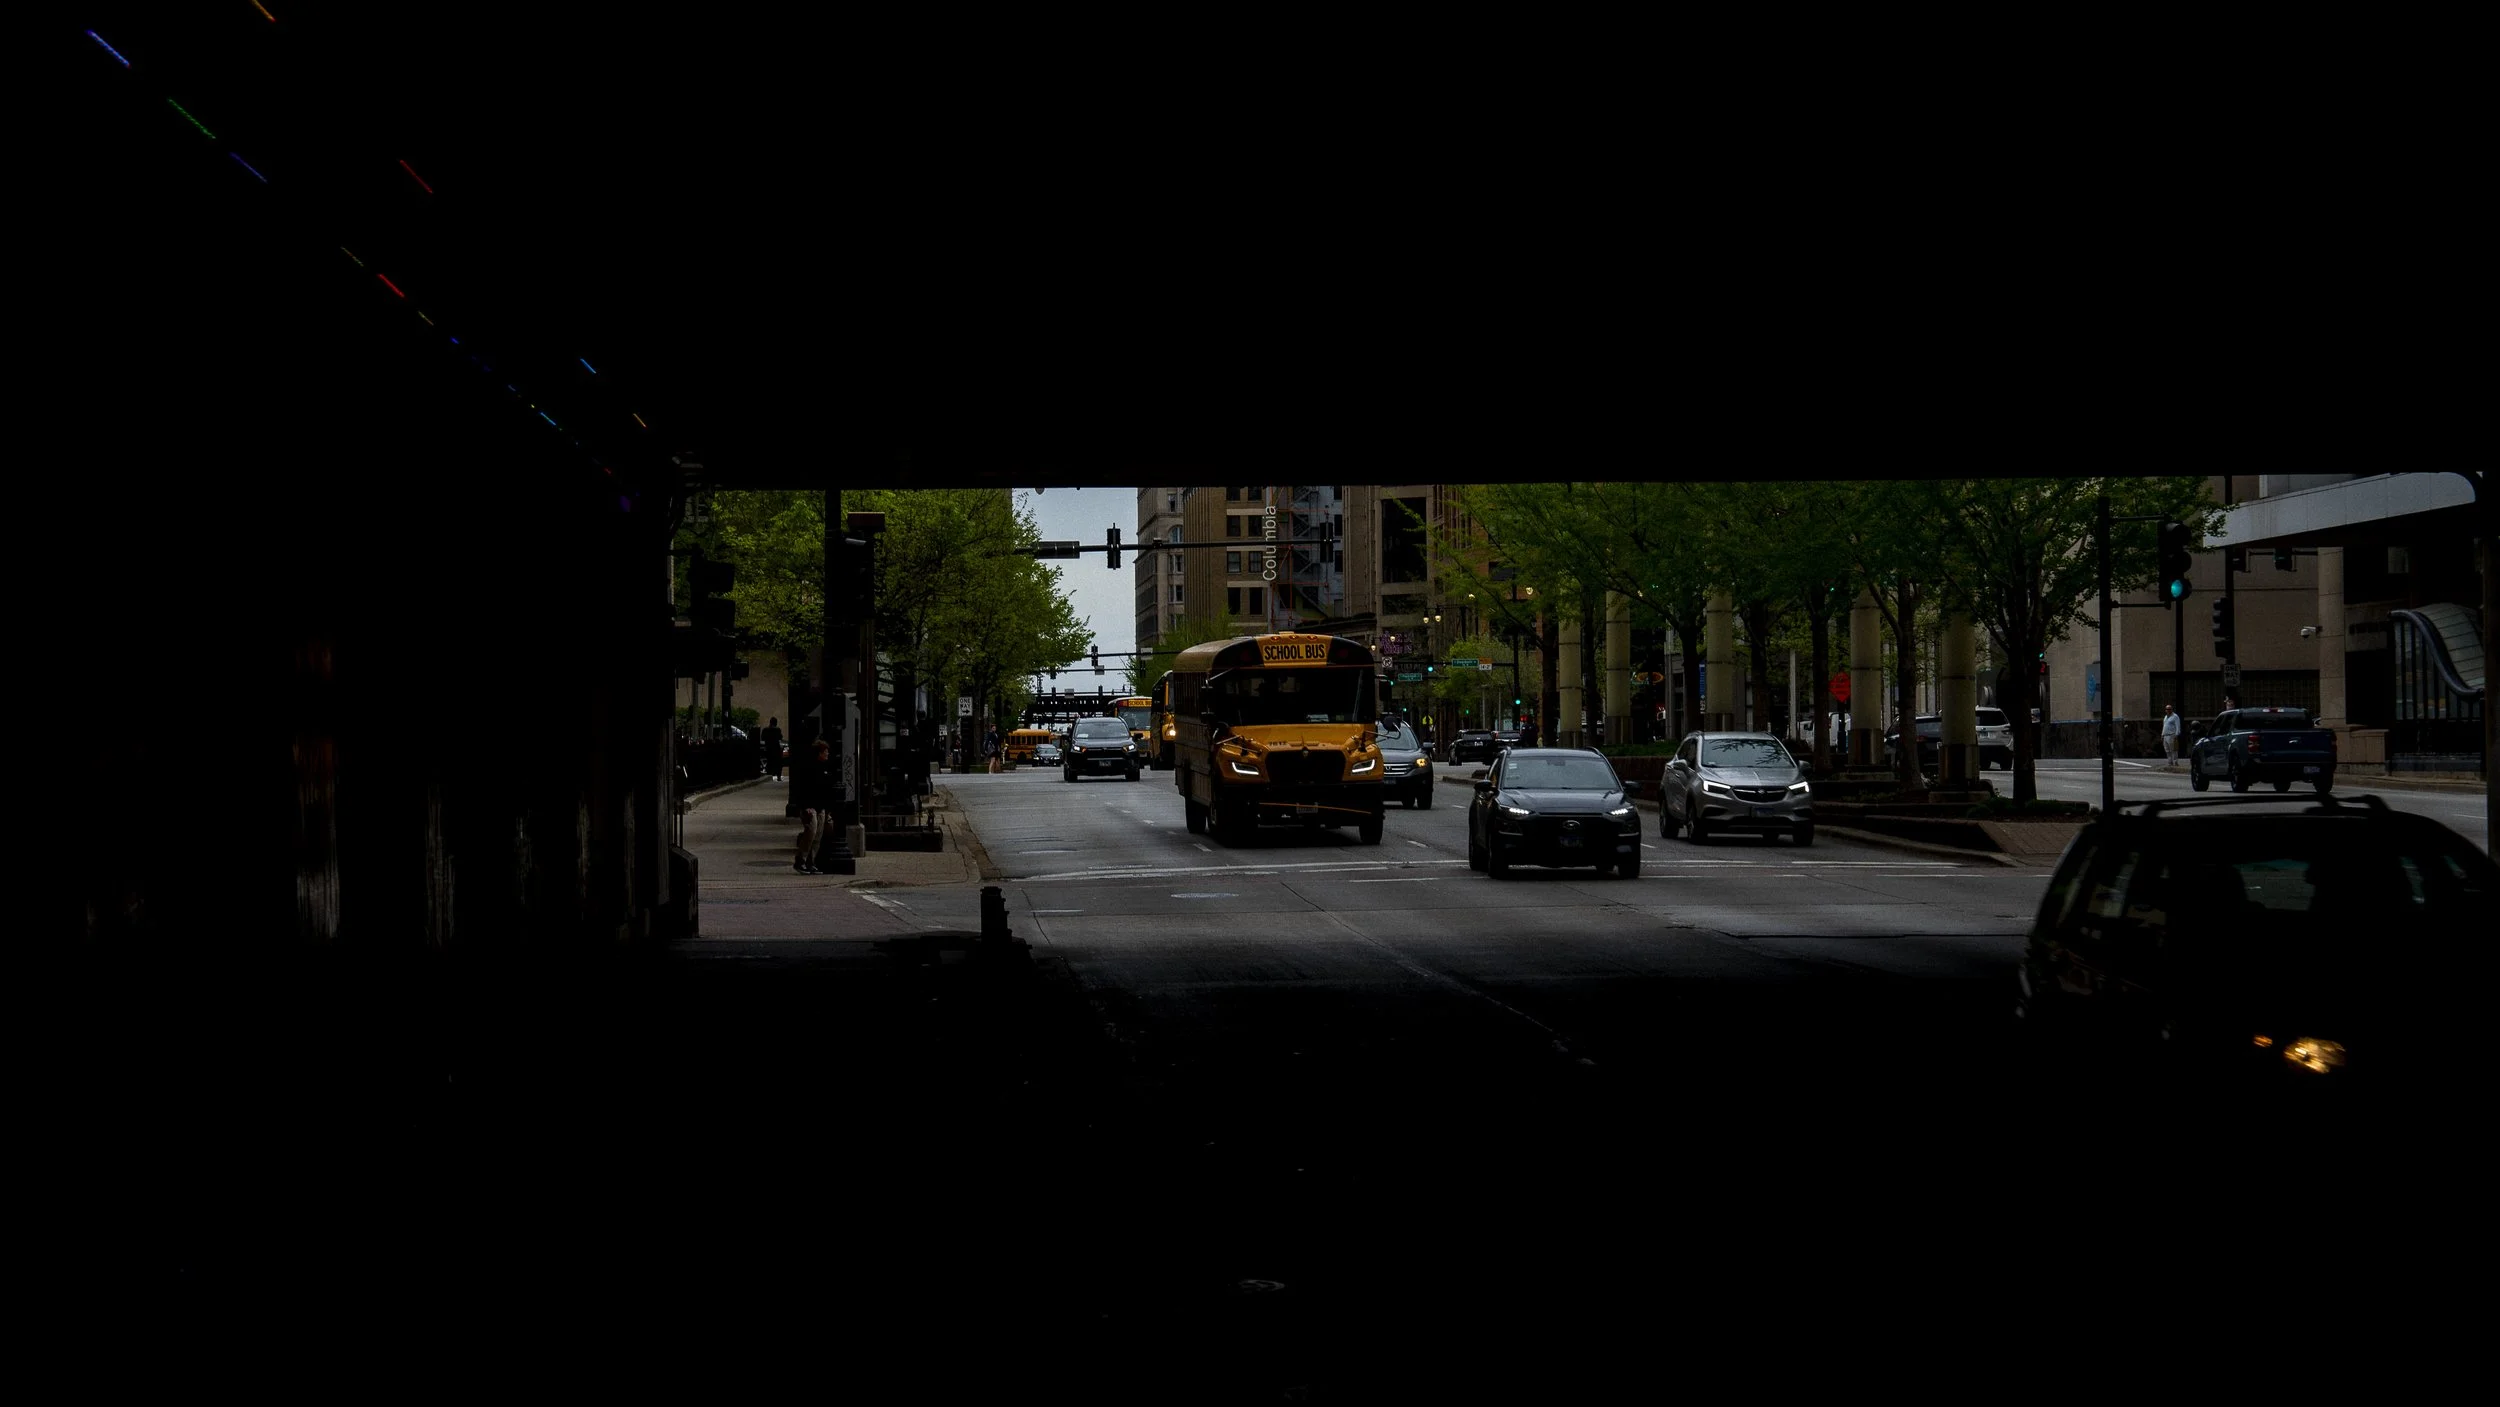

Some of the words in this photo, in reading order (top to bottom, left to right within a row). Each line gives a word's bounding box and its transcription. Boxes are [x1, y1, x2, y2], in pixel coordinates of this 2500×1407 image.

[1262, 505, 1277, 581] Columbia
[1264, 645, 1304, 660] SCHOOL
[1305, 644, 1325, 659] BUS
